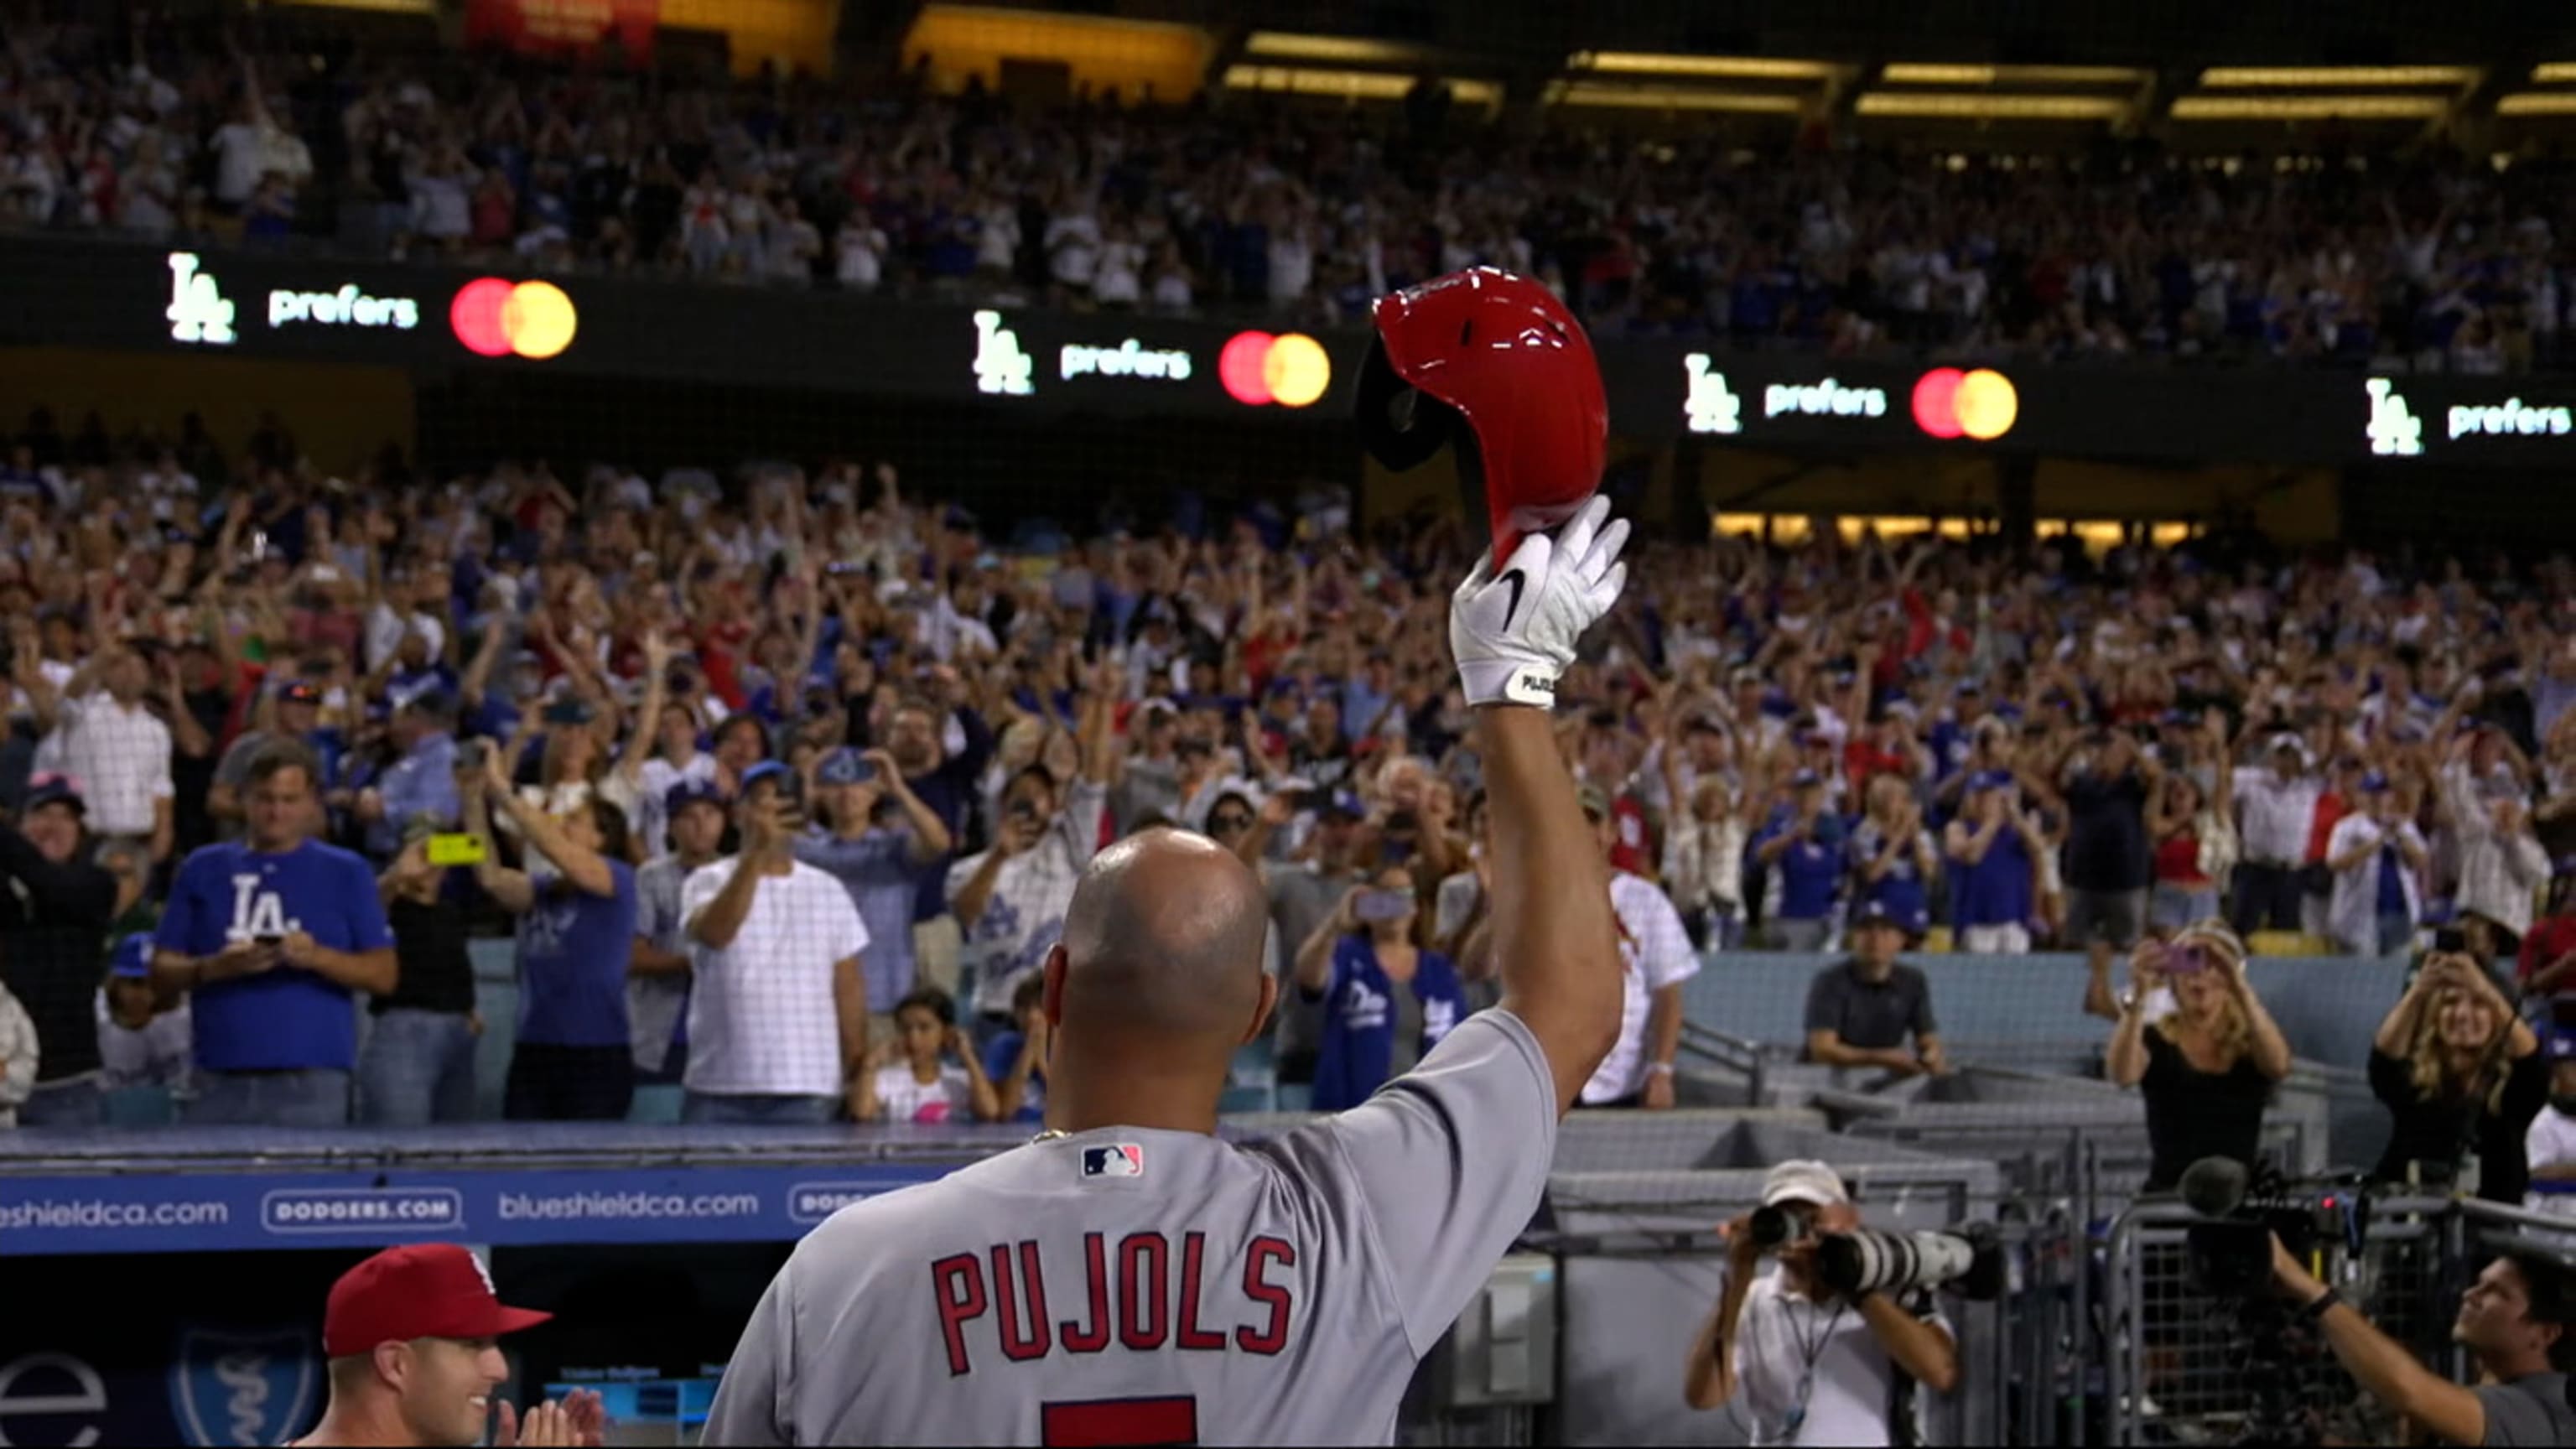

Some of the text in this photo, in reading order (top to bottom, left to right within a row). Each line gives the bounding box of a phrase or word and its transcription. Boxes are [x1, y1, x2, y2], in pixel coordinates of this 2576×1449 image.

[269, 283, 418, 329] prefers
[1061, 339, 1191, 380] prefers
[1765, 378, 1887, 418] prefers
[2449, 397, 2572, 439] prefers
[275, 1200, 450, 1220] DODGERS.COM
[499, 1192, 759, 1219] blueshieldca.com
[932, 1231, 1296, 1378] PUJOLS
